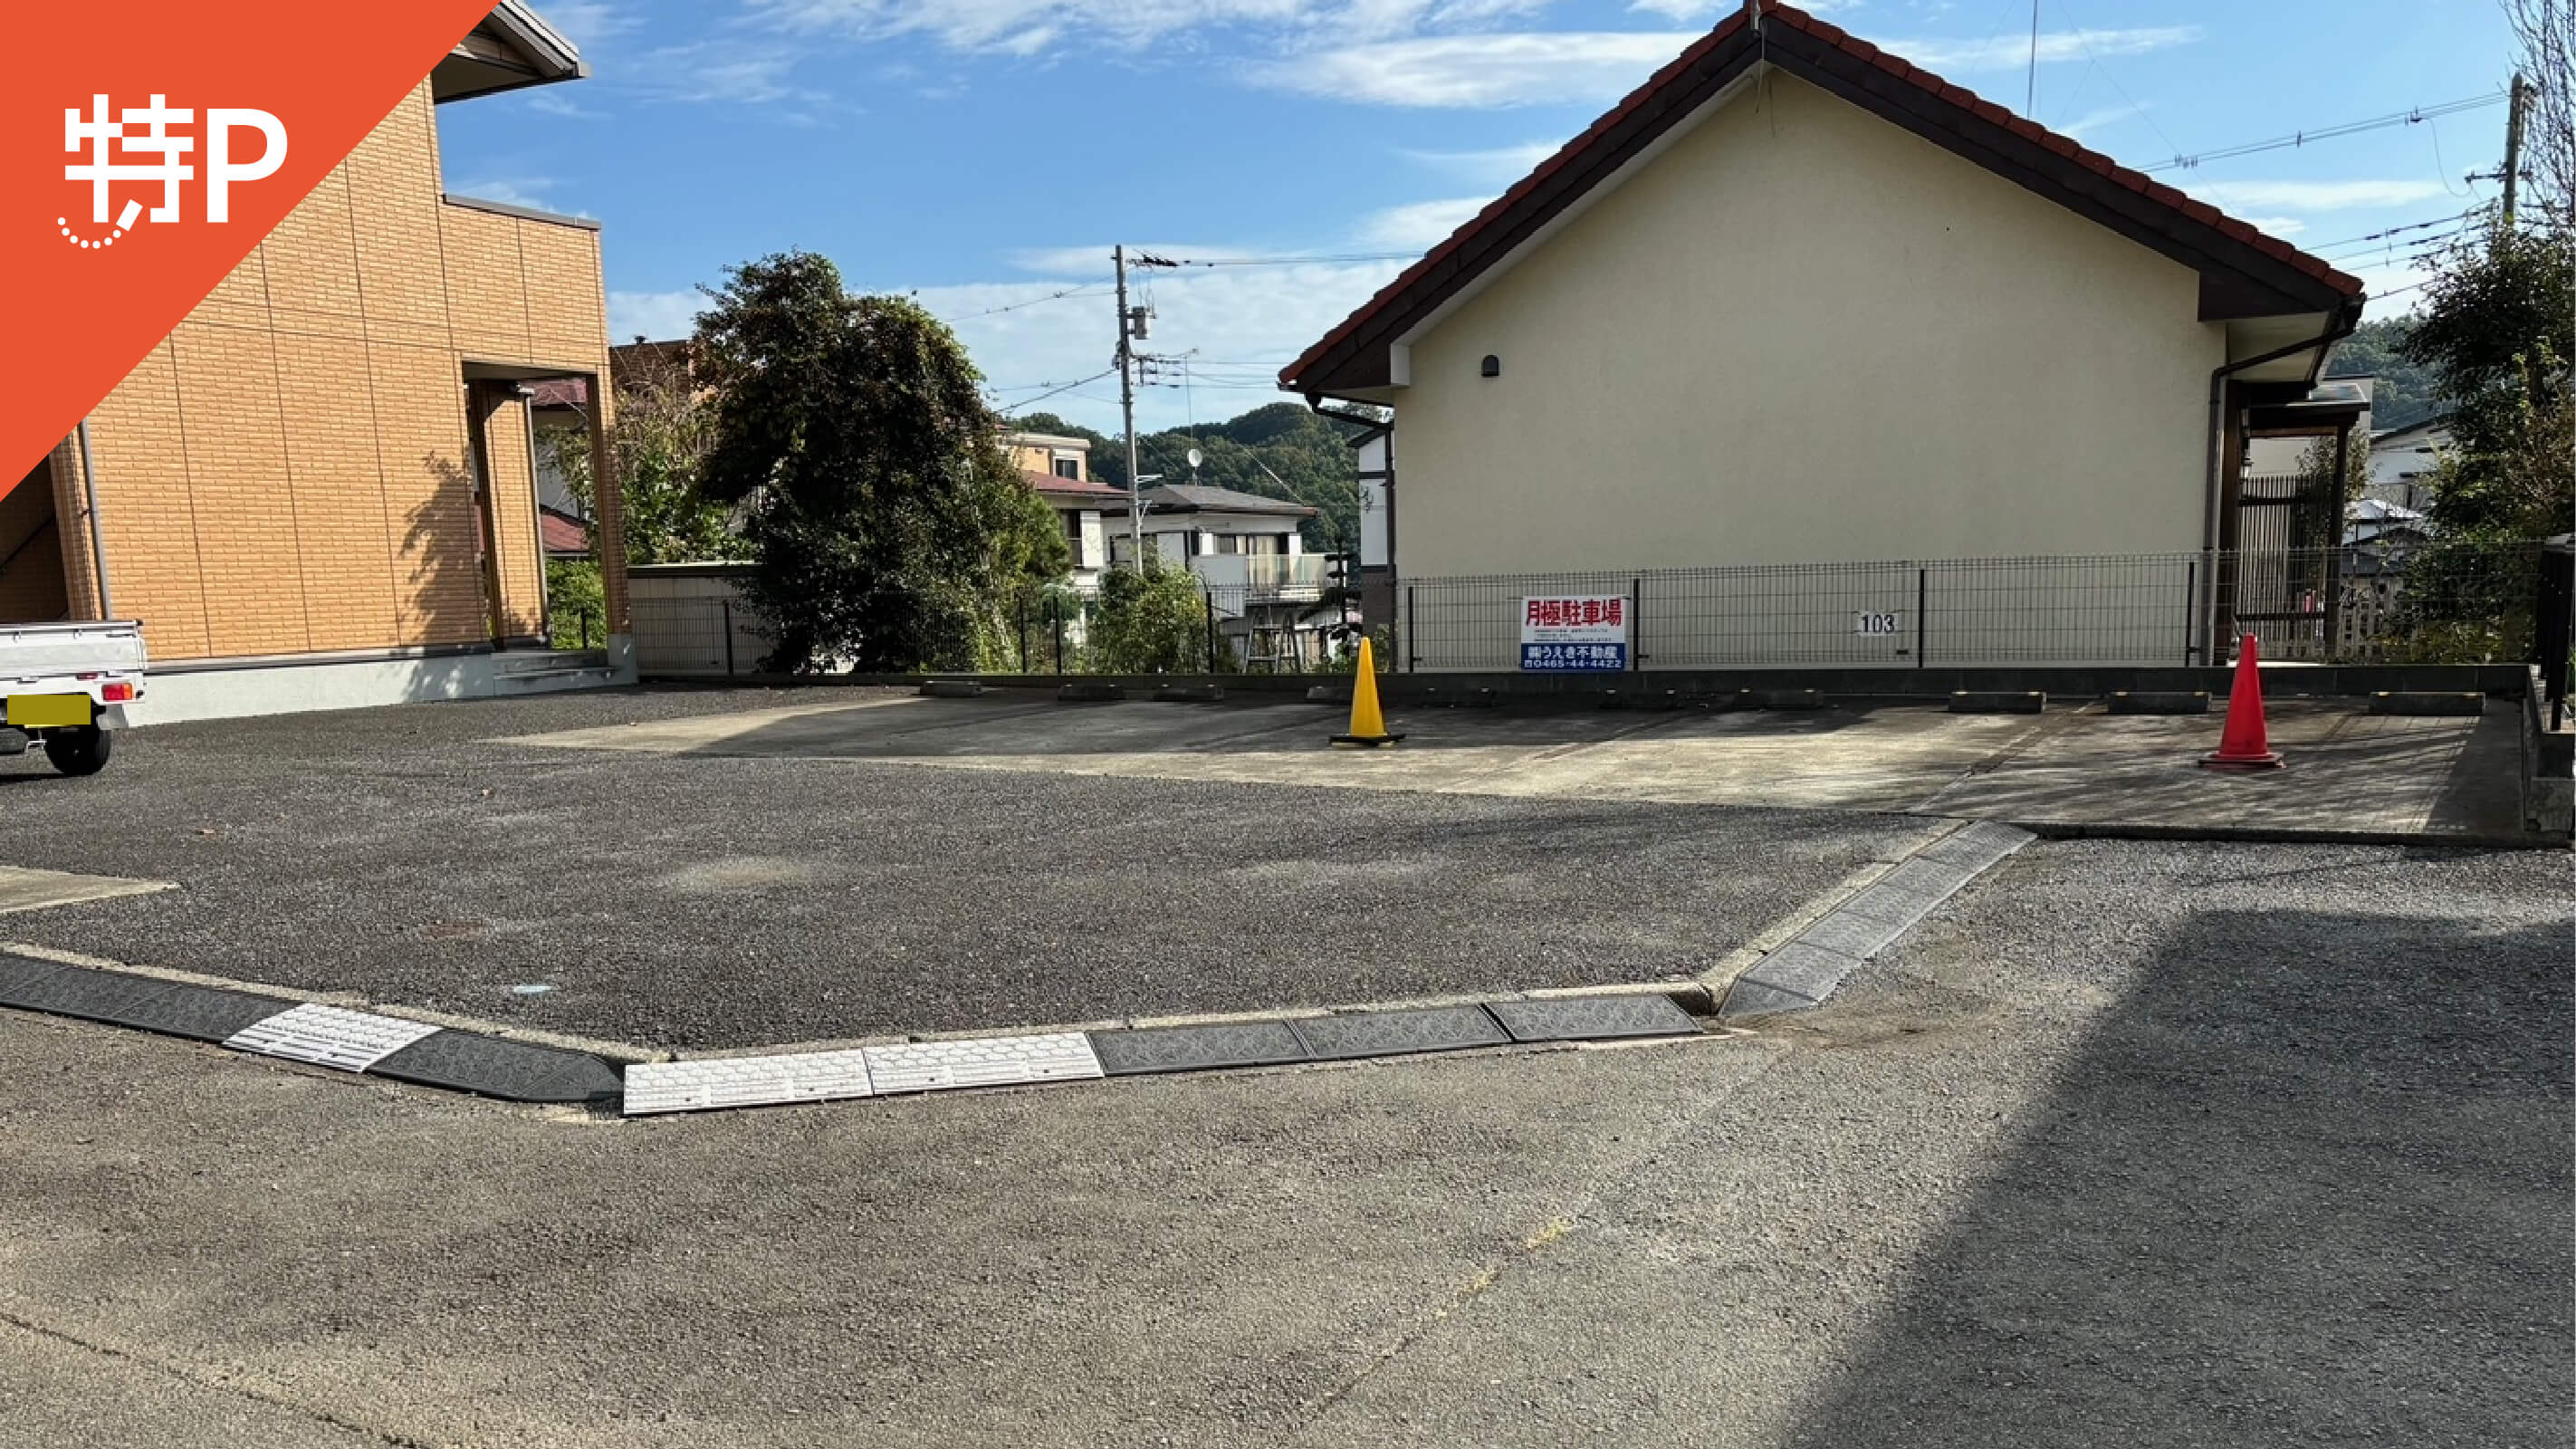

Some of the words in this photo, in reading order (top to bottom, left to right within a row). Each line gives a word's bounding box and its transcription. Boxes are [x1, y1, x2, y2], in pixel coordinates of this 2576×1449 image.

[1526, 599, 1623, 627] 月極駐車場
[1862, 614, 1895, 633] 103
